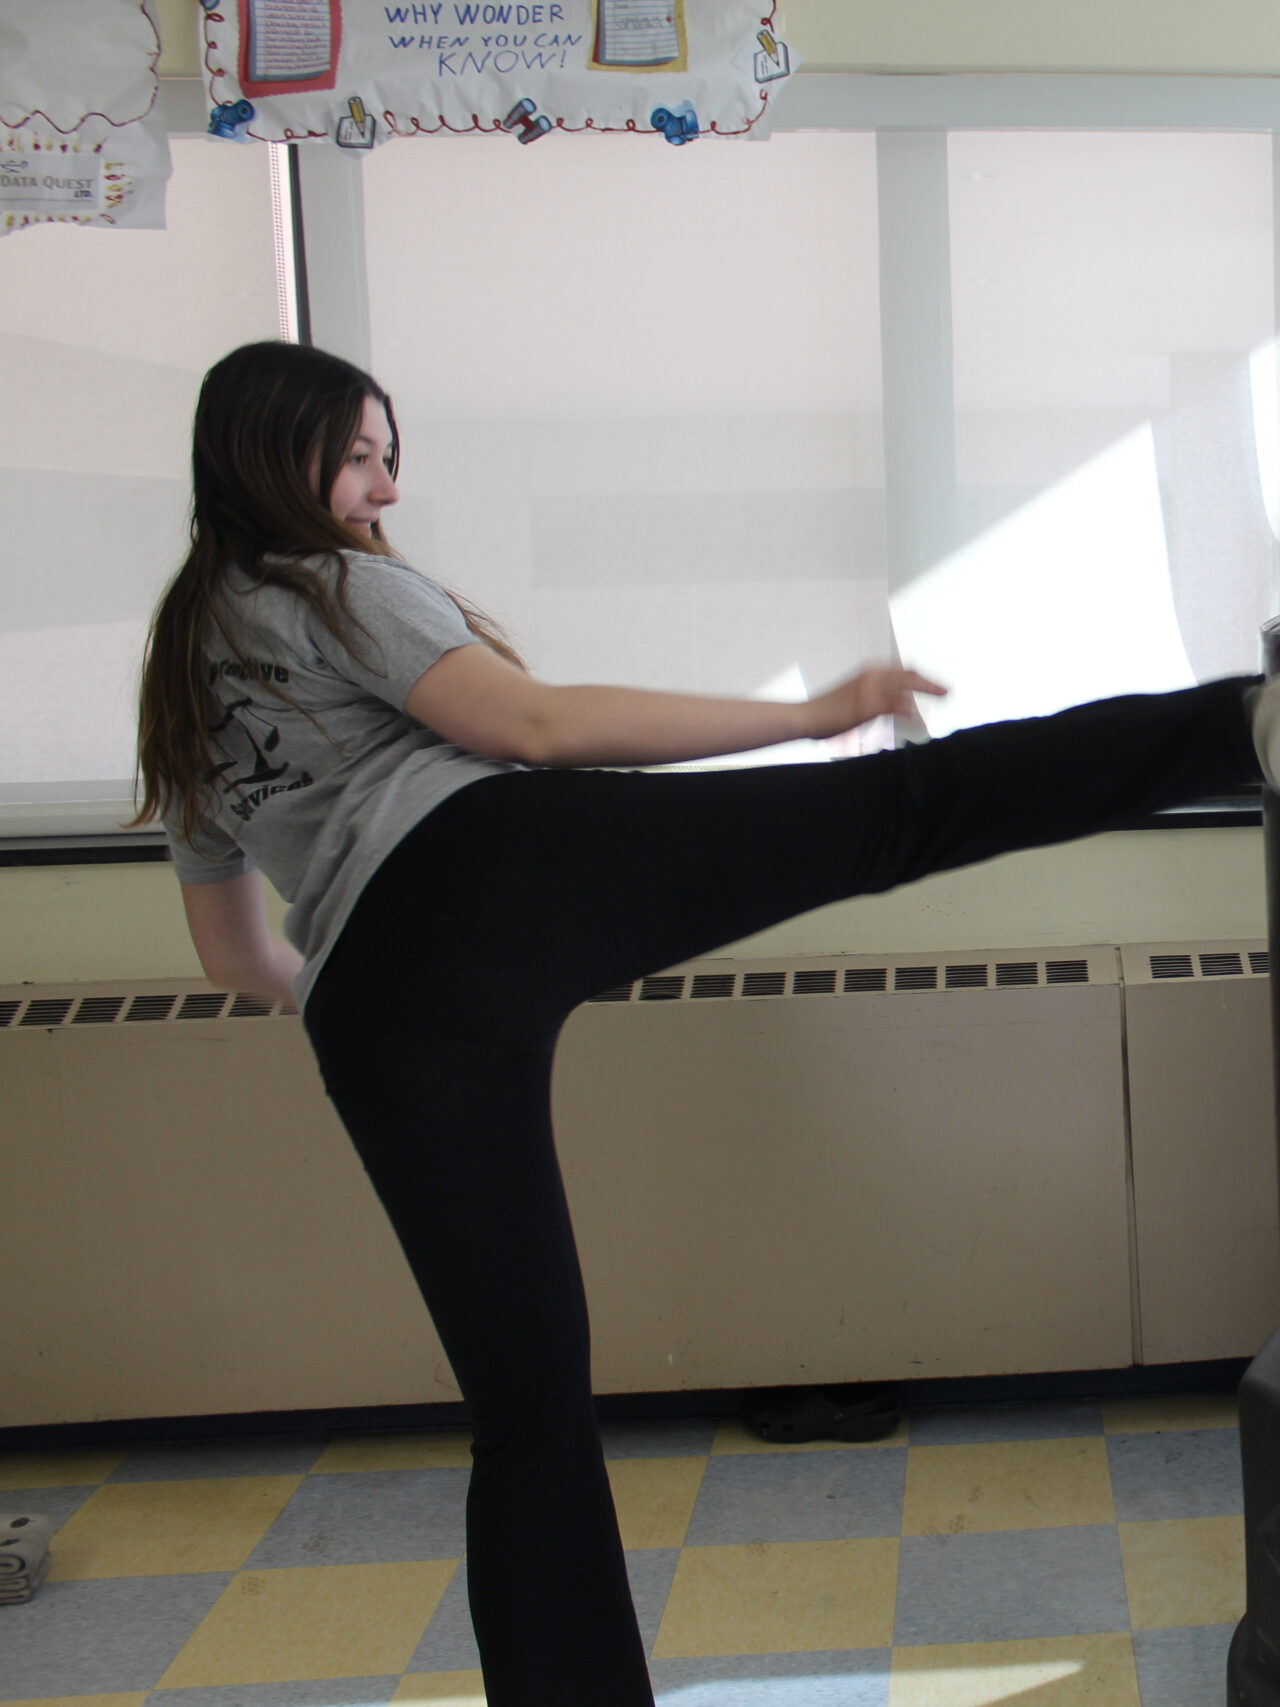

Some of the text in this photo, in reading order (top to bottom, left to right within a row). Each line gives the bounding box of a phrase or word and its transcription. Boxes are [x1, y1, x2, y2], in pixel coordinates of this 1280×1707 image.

[384, 3, 565, 26] WHY WONDER
[389, 32, 583, 50] WHEN YOU CAN
[438, 50, 567, 78] KNOW!
[1, 174, 94, 190] DATA QUEST
